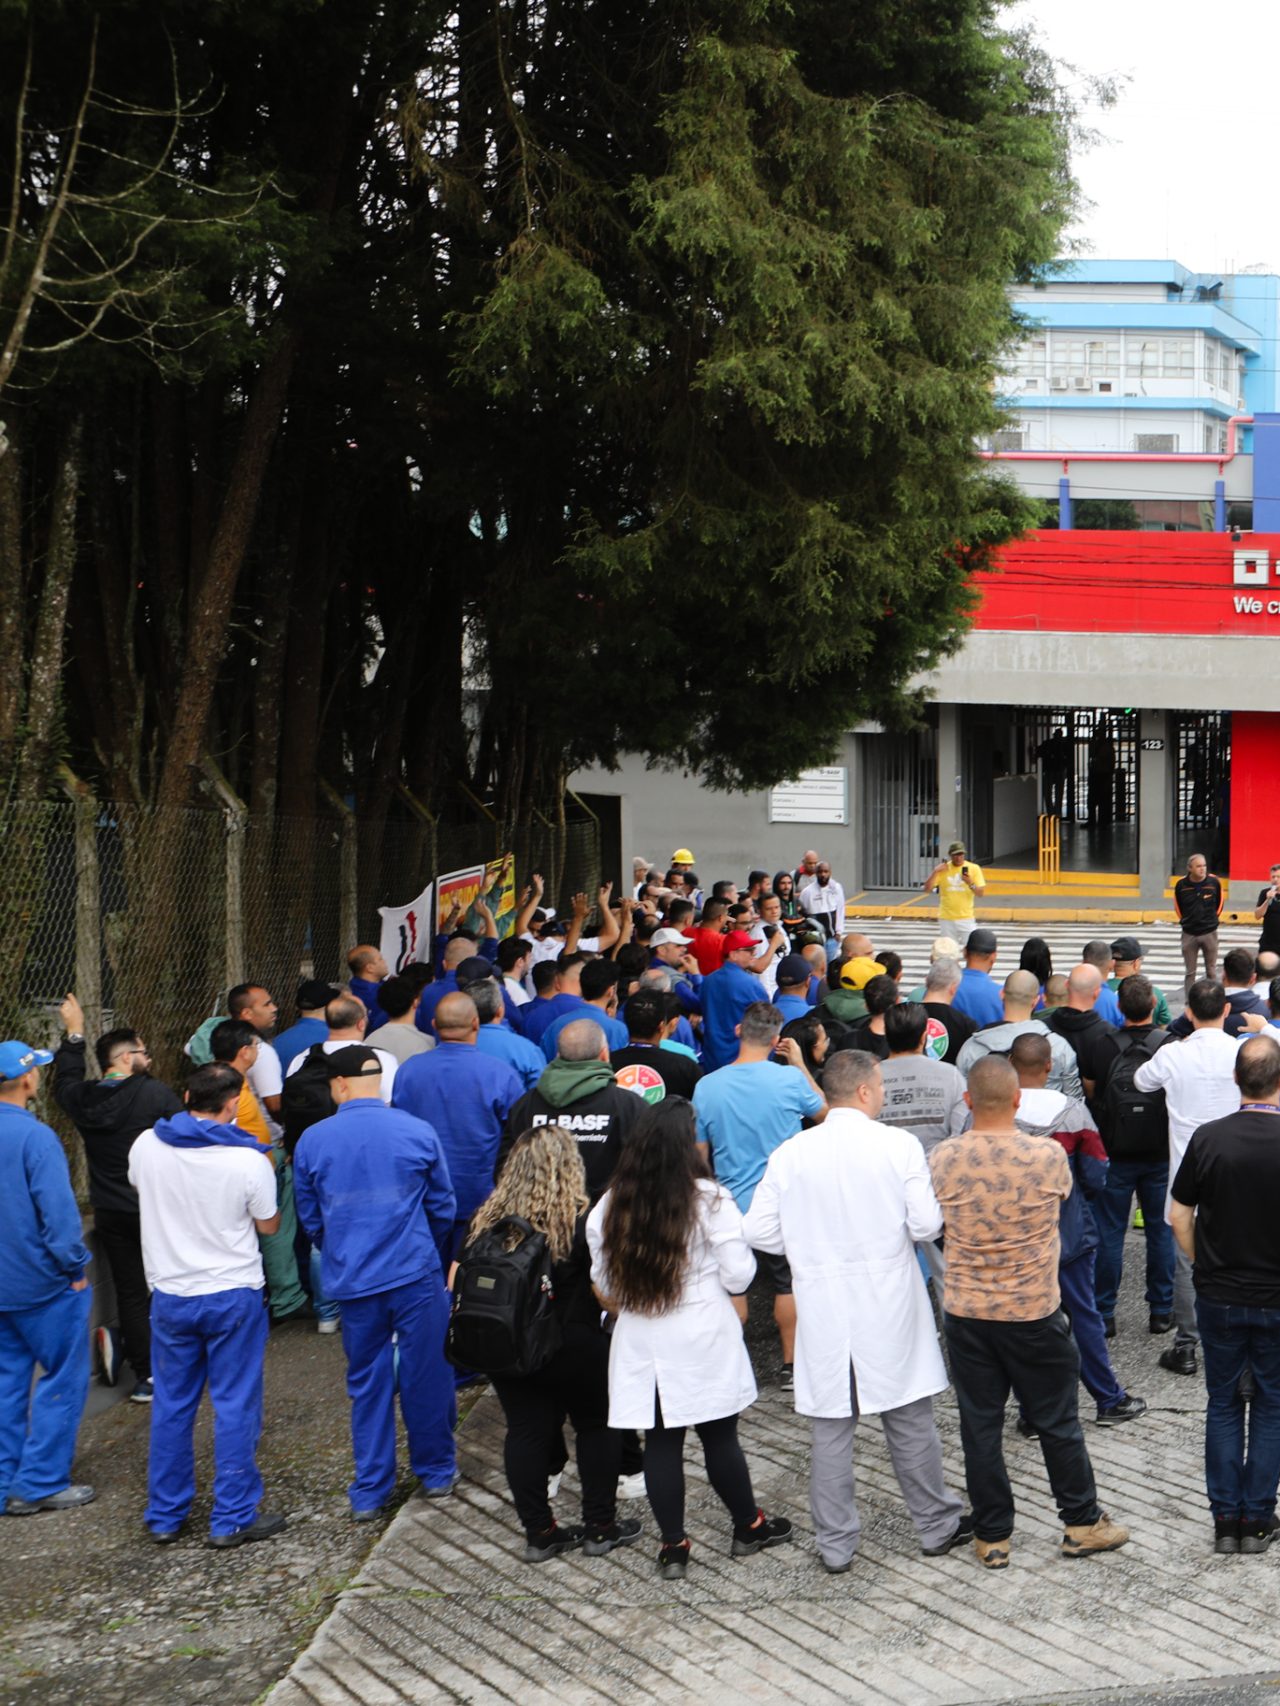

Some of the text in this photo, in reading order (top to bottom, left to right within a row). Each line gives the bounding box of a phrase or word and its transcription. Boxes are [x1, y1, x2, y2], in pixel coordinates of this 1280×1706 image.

[1233, 596, 1263, 614] We
[1144, 740, 1160, 750] 123
[558, 1114, 610, 1130] BASF
